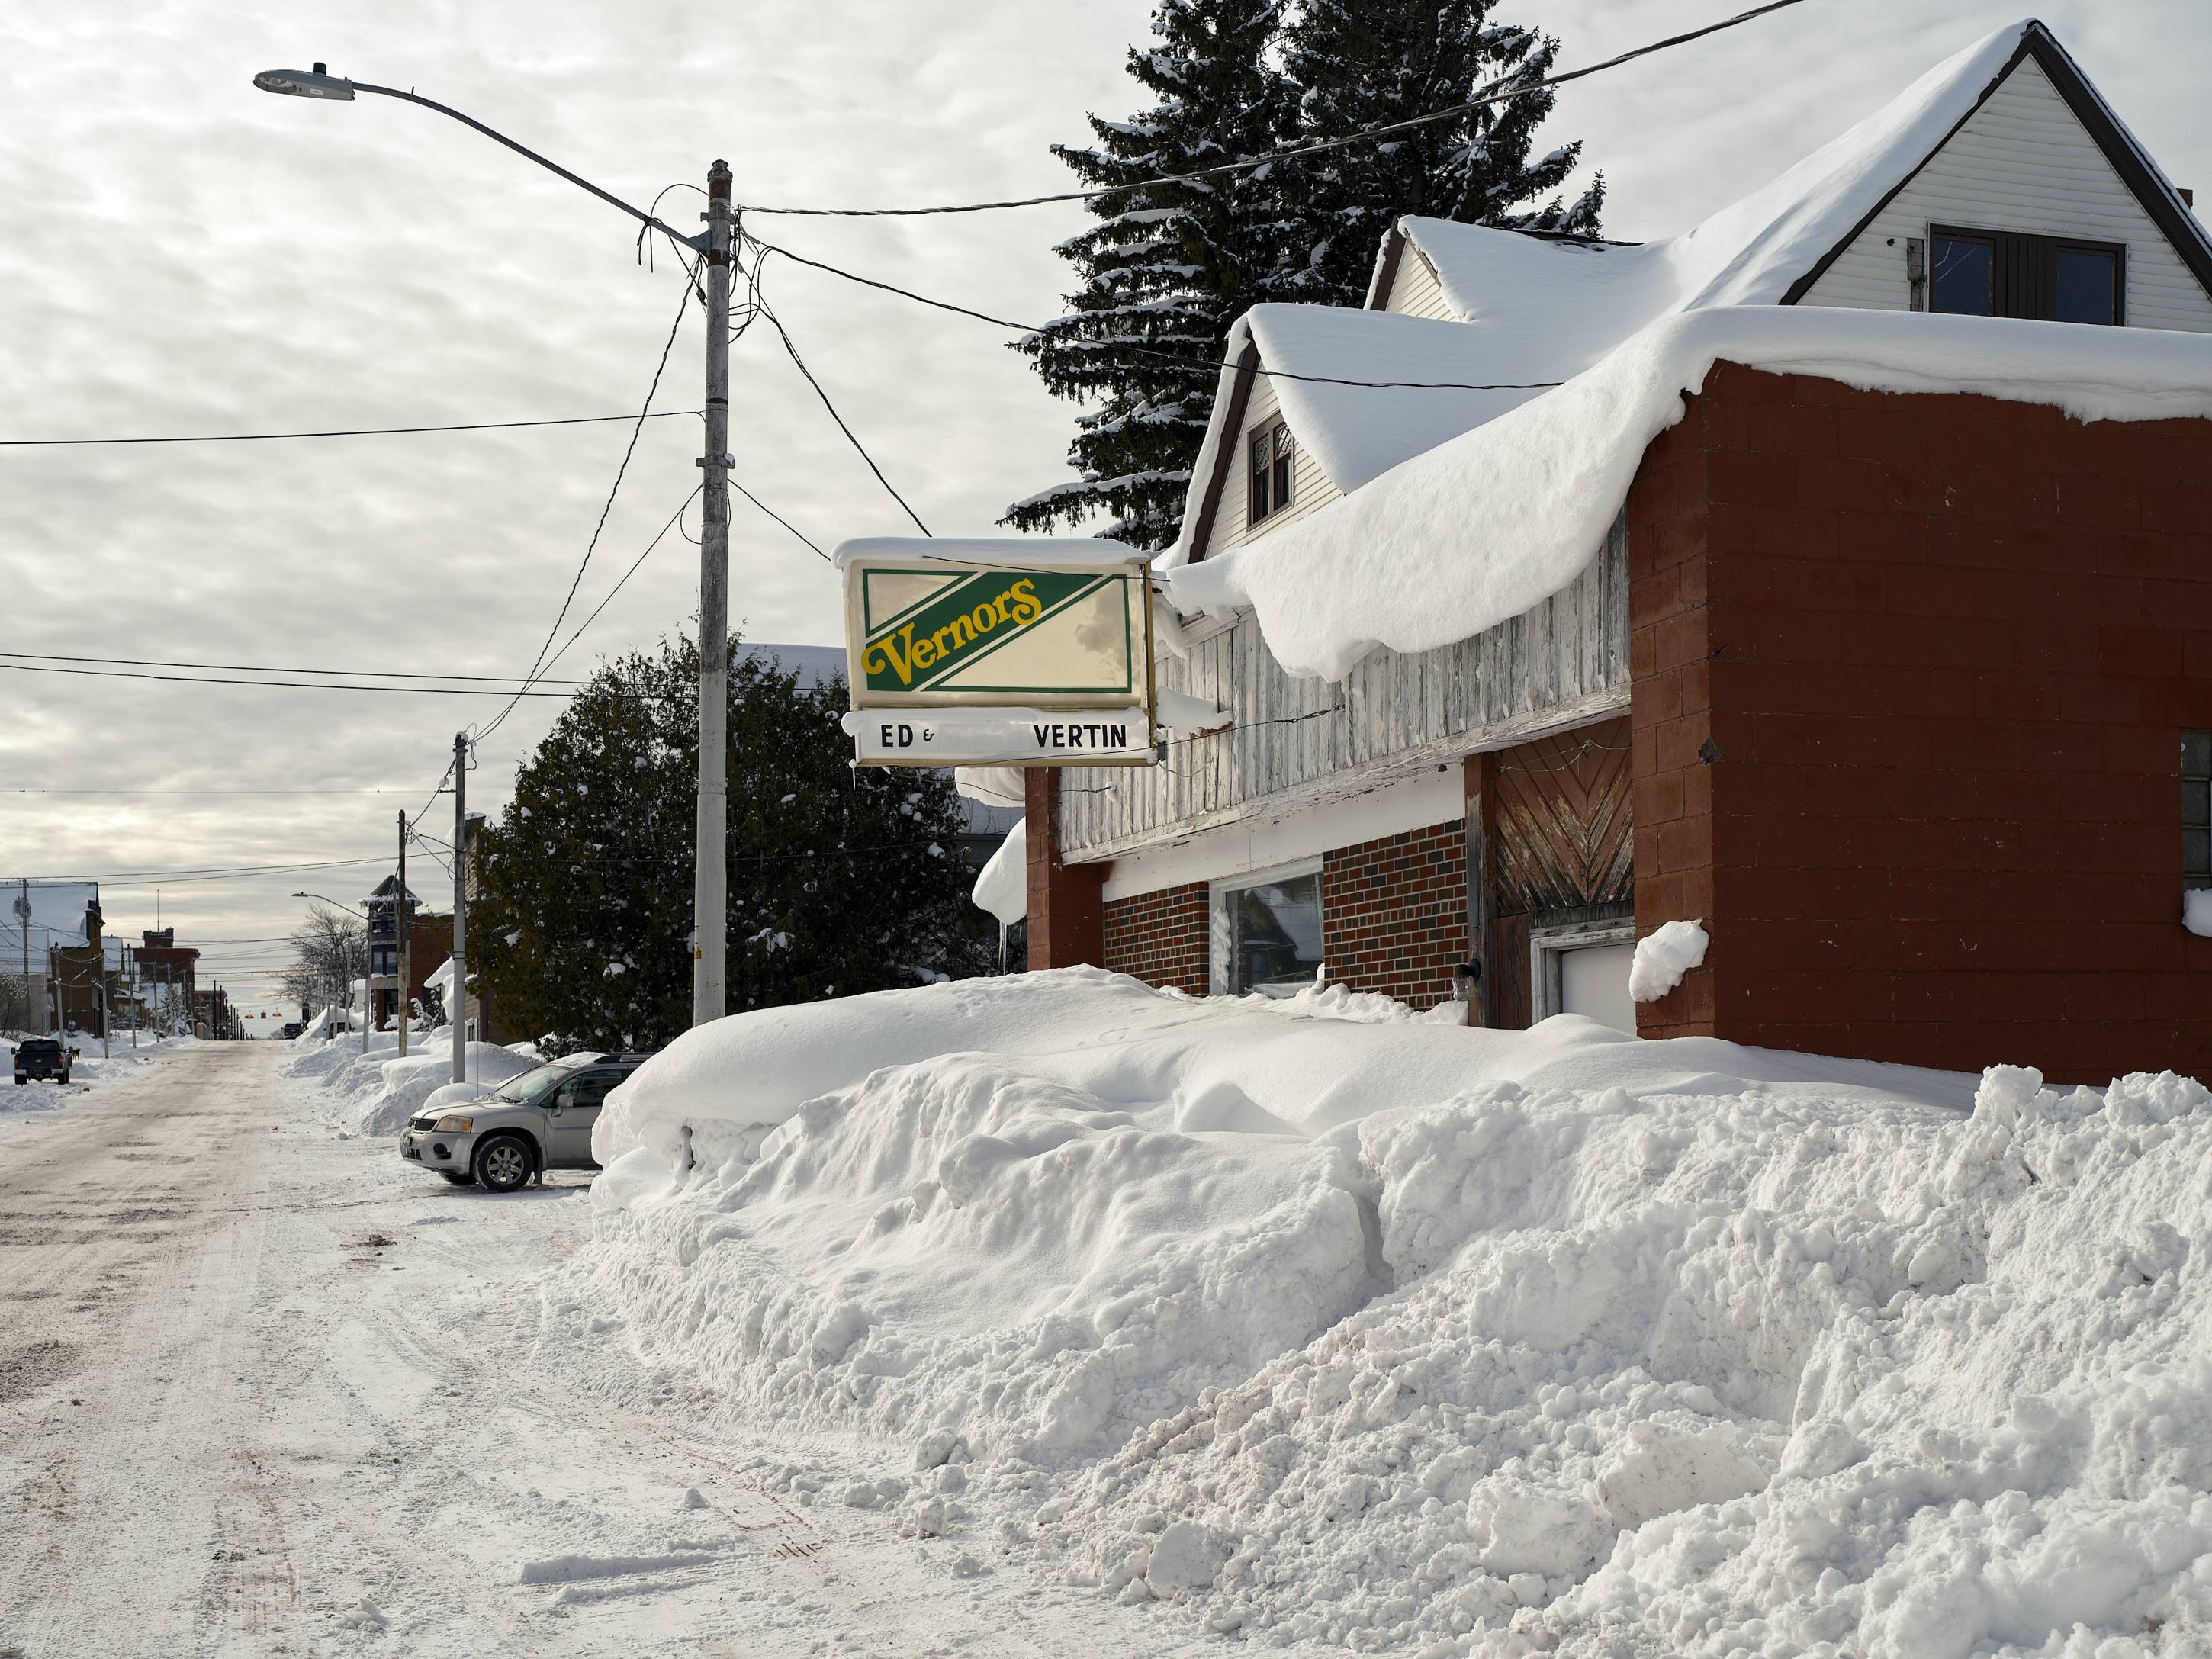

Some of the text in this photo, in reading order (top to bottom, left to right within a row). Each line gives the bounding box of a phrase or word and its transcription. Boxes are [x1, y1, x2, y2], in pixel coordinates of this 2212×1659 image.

[861, 577, 1042, 685] Vernors
[880, 724, 1127, 748] ED & VERTIN
